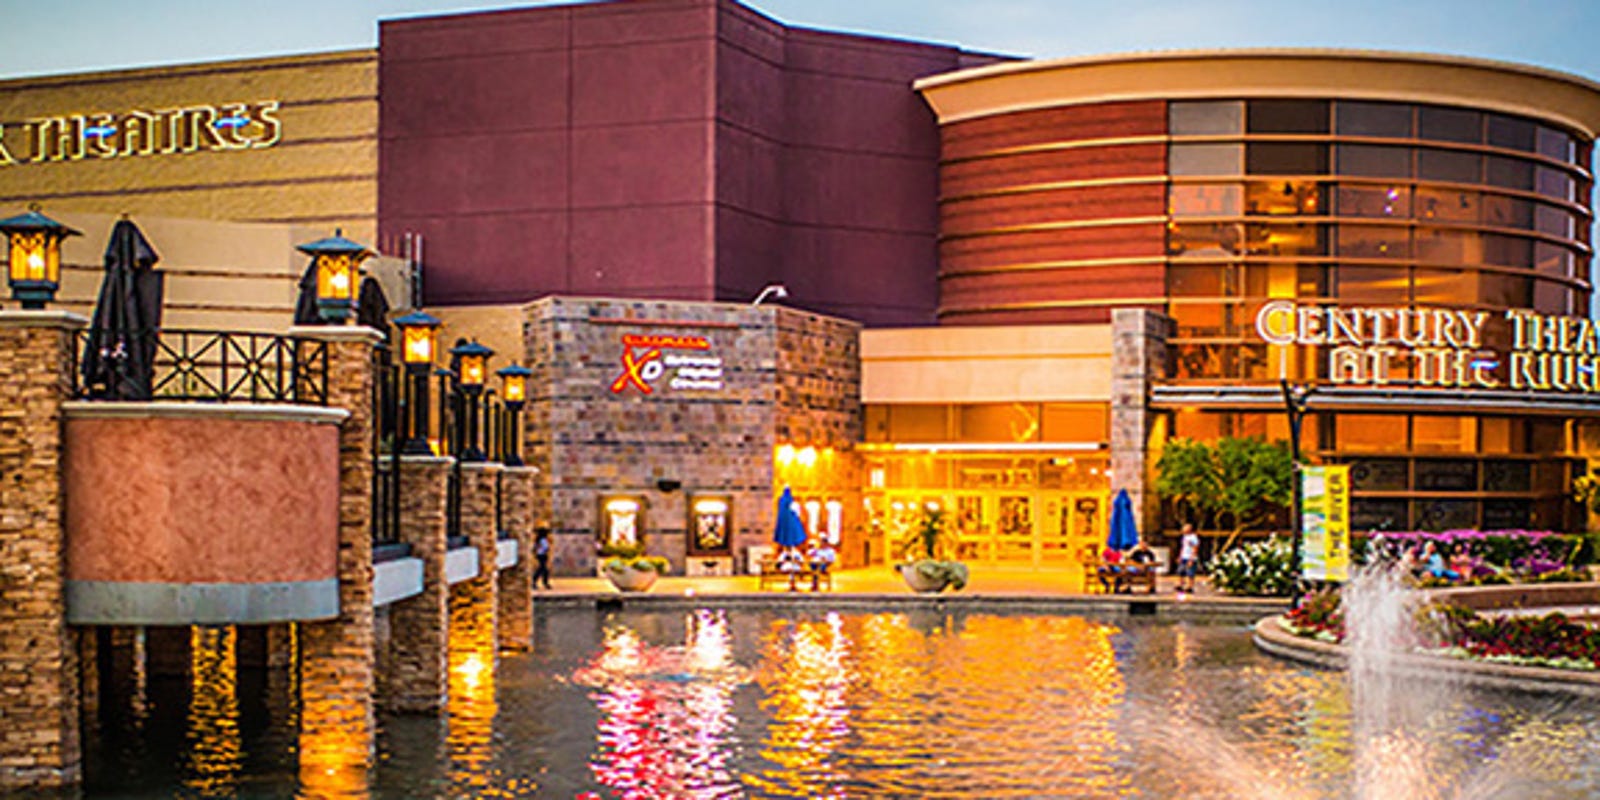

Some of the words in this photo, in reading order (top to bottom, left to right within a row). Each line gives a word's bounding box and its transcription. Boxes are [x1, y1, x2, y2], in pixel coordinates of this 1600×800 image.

[23, 99, 281, 162] THEATRES
[1256, 301, 1489, 347] CENTURY
[1505, 308, 1600, 354] THEA
[1329, 346, 1398, 384] AT
[1413, 347, 1499, 387] THE
